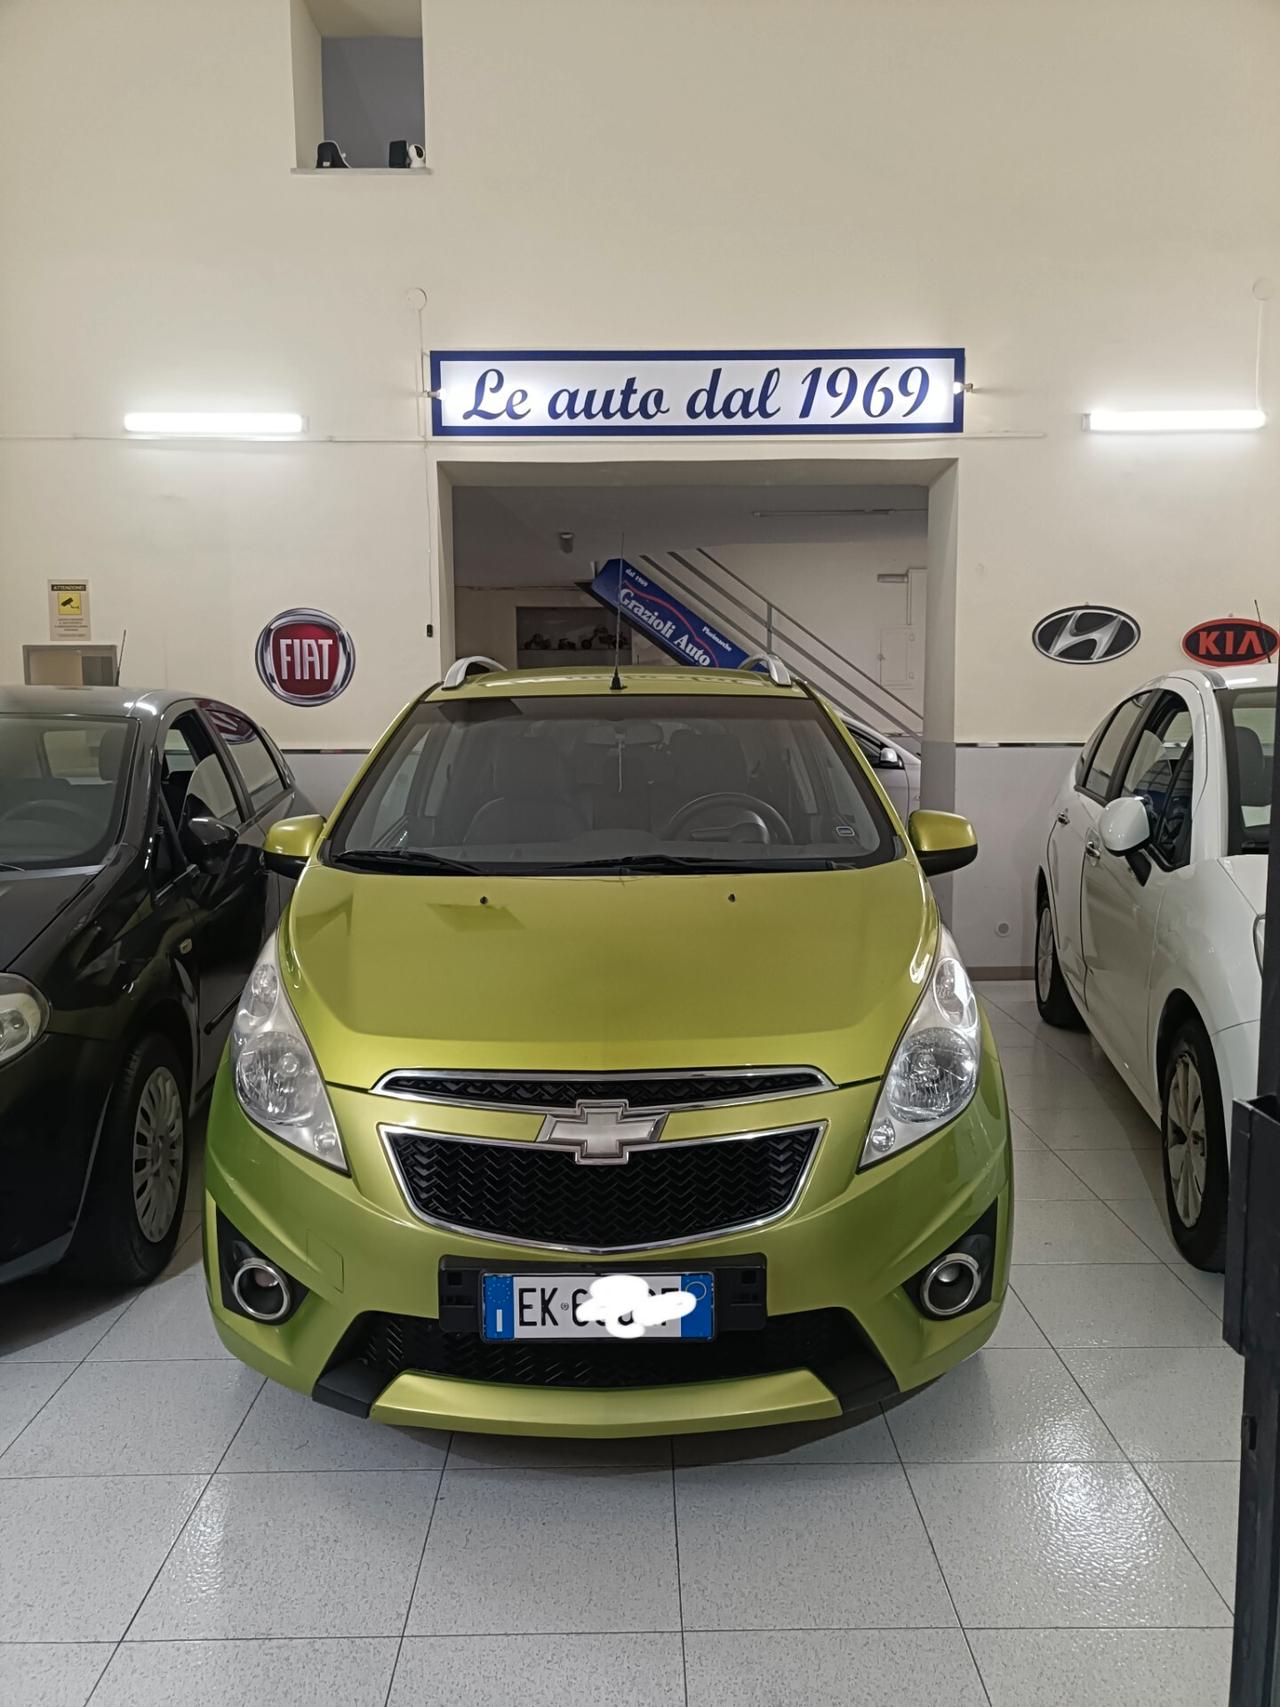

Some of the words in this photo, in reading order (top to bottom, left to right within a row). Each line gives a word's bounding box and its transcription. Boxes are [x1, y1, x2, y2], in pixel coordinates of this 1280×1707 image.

[462, 368, 531, 421] Le
[547, 375, 670, 421] auto
[686, 367, 781, 420] dal
[798, 365, 931, 420] 1969
[620, 589, 676, 640] Grazioli
[674, 635, 711, 666] Auto
[1198, 630, 1264, 656] KIA
[279, 638, 333, 680] FIAT
[518, 1287, 559, 1327] EK
